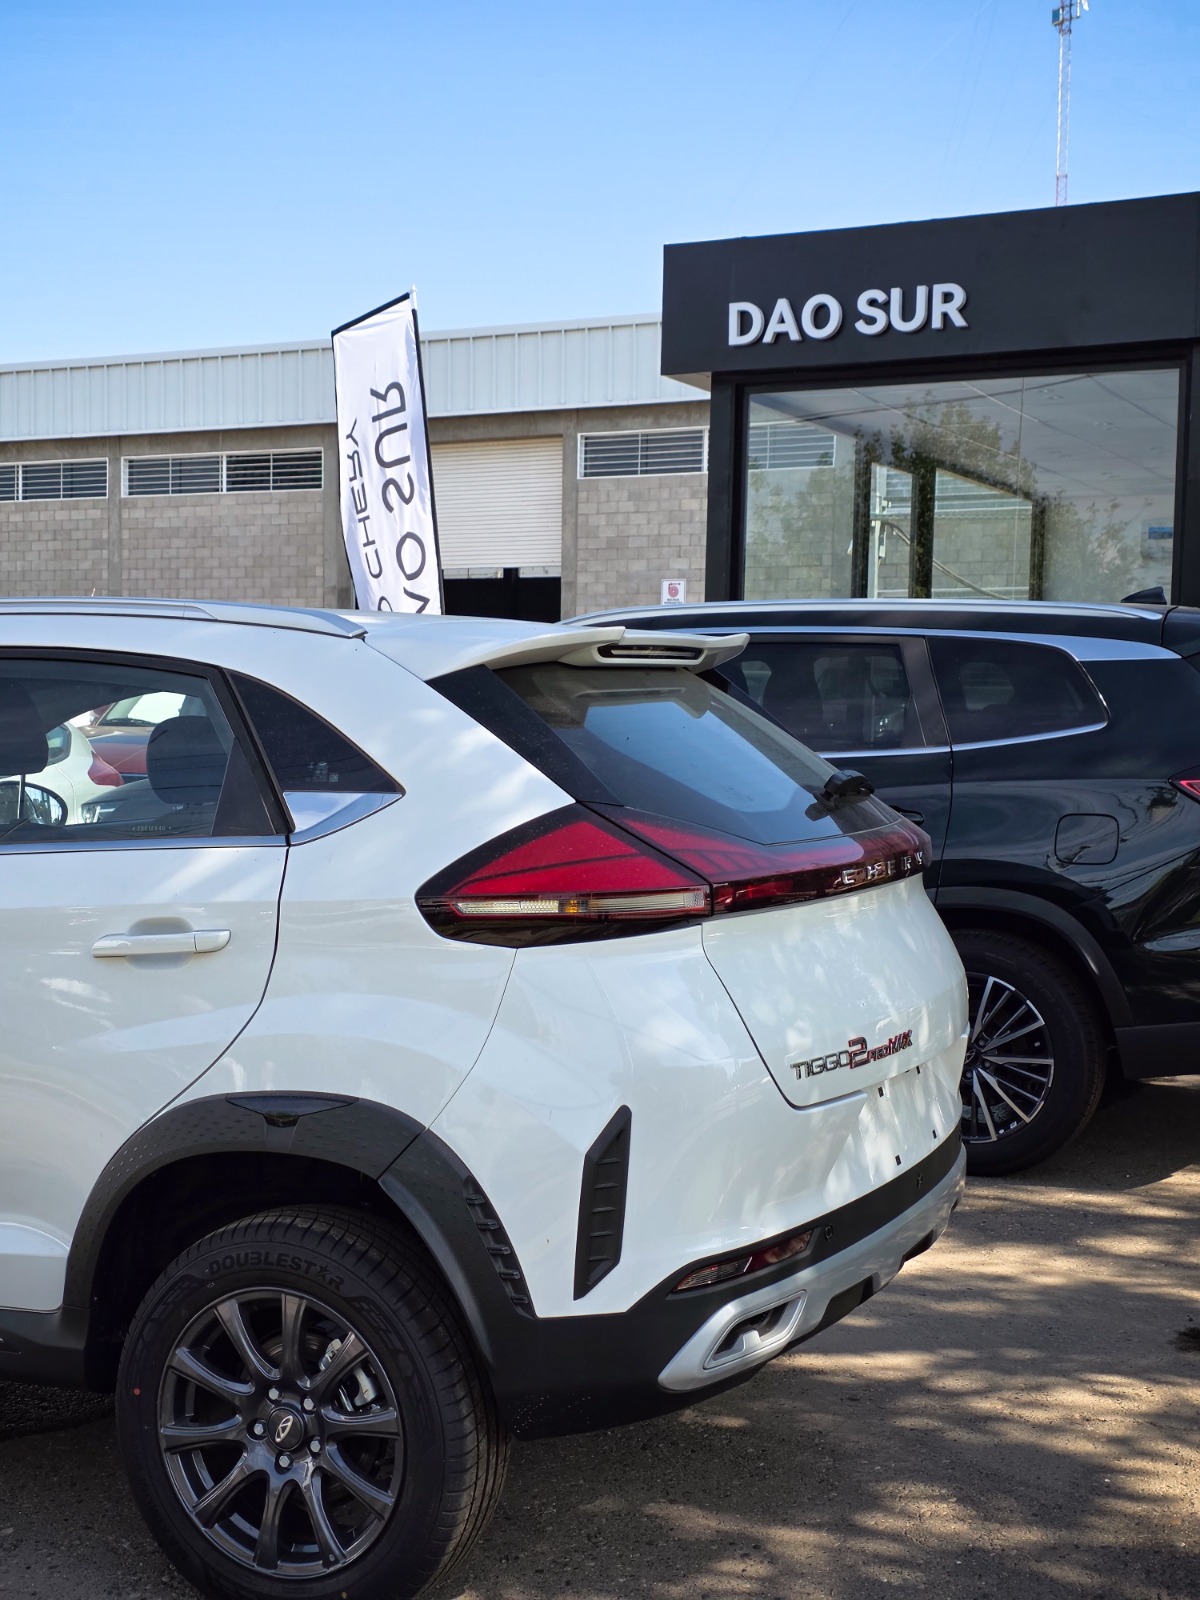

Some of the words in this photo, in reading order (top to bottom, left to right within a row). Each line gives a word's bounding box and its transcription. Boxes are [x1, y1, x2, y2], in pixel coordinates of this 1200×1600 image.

[728, 293, 843, 346] DAO
[854, 282, 969, 336] SUR
[842, 851, 923, 885] CHERY
